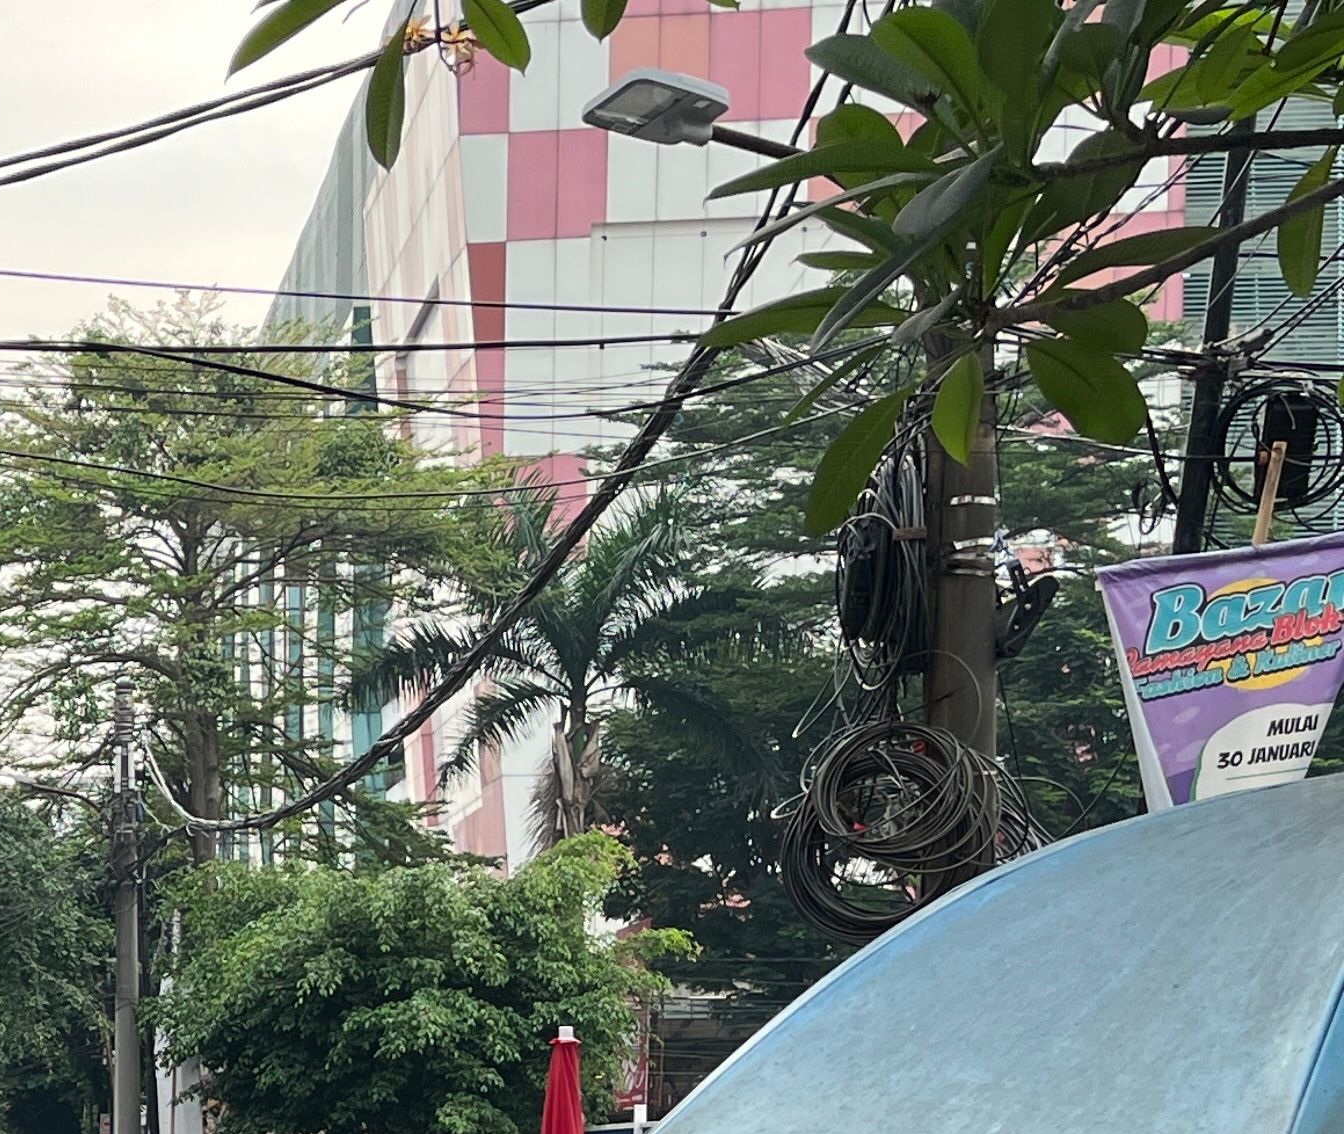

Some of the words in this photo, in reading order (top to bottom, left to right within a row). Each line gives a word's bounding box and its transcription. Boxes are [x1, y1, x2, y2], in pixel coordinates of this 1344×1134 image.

[1266, 713, 1320, 738] MULAI
[1217, 751, 1243, 769] 30
[1247, 741, 1317, 765] JANUARI
